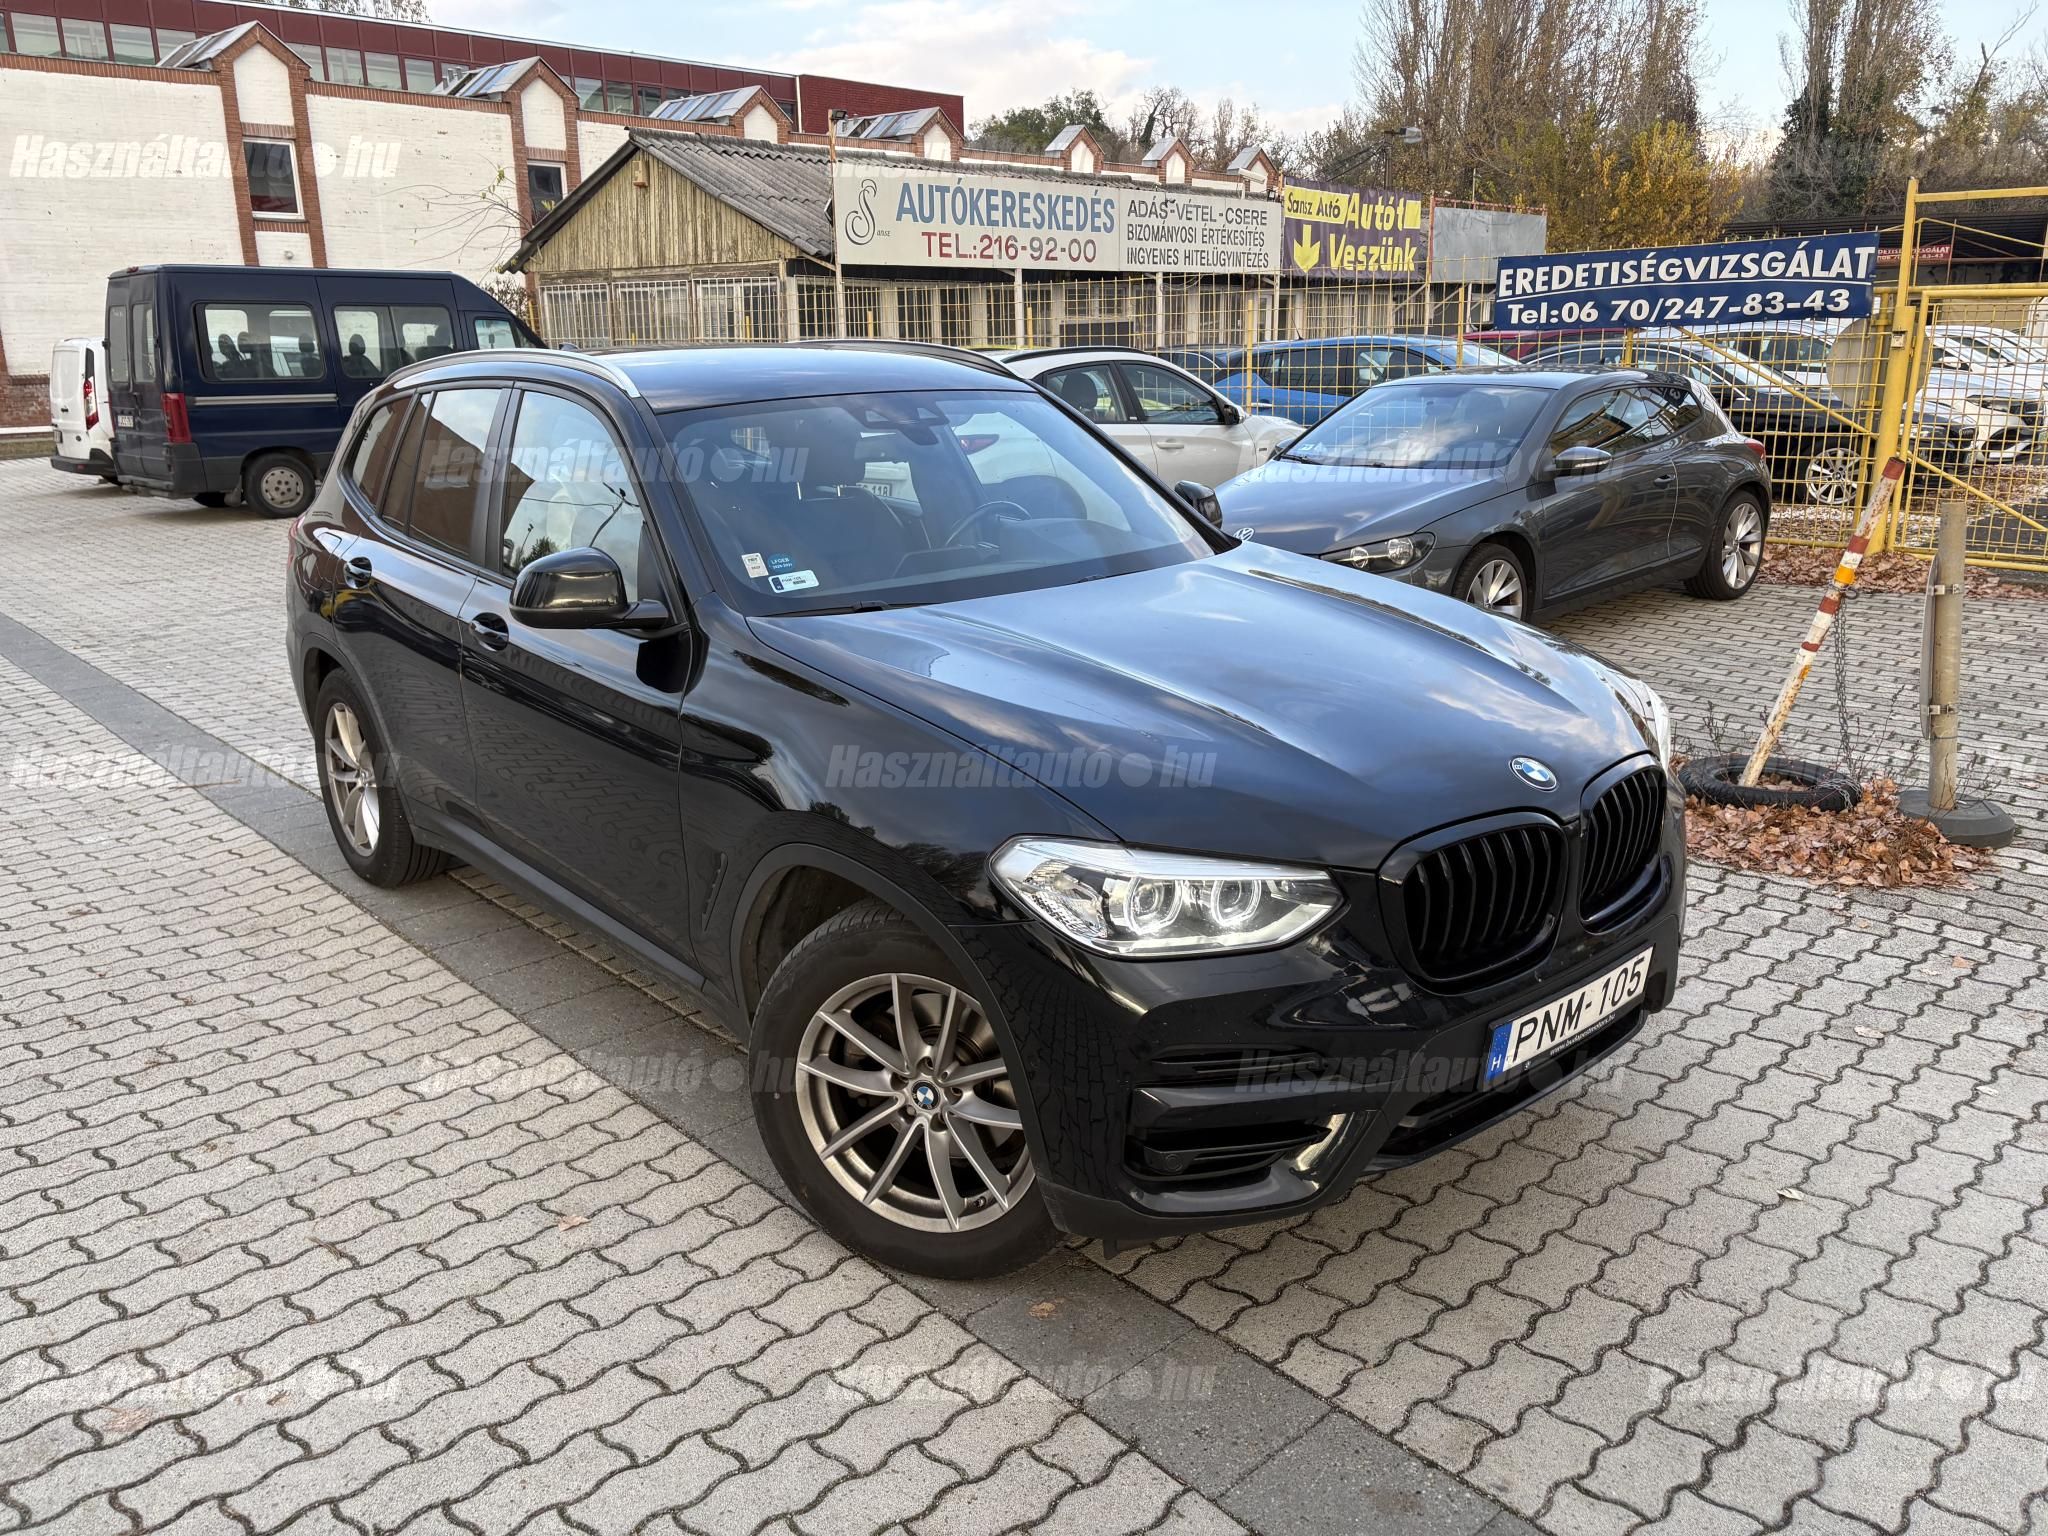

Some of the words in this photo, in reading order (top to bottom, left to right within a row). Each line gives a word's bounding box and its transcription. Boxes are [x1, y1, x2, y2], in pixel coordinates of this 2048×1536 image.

[895, 178, 1115, 234] AUTÓKERESKEDÉS
[1287, 191, 1313, 216] Sansz
[1345, 191, 1404, 231] Autót
[1126, 220, 1198, 244] BIZOMÁNYOSI
[1201, 223, 1265, 247] ÉRTÉKESÍTÉS
[1329, 233, 1418, 272] Veszünk
[1126, 246, 1179, 266] INGYENES
[1183, 248, 1270, 269] HITELÜGYINTÉZÉS
[1499, 241, 1876, 298] EREDETISÉGVIZSGÁLAT
[1508, 301, 1599, 325] Tel:06
[1611, 288, 1850, 323] 70/247-83-43
[1512, 956, 1646, 1063] PNM-105
[1491, 1055, 1502, 1072] H
